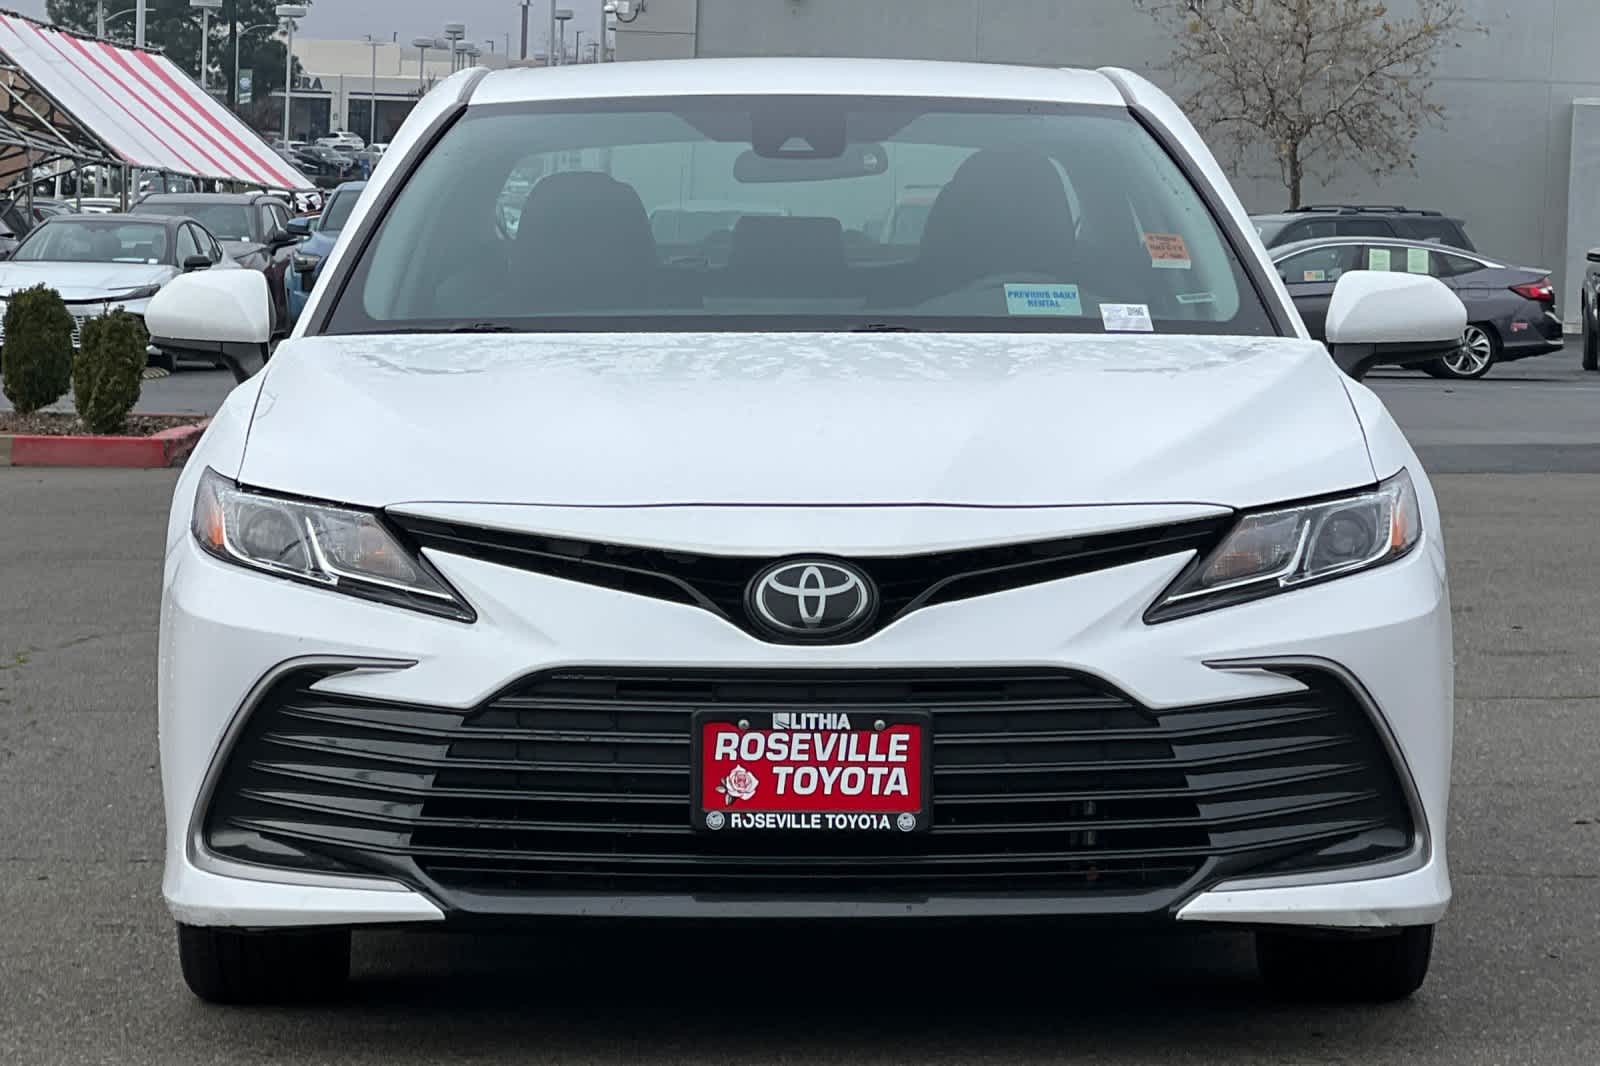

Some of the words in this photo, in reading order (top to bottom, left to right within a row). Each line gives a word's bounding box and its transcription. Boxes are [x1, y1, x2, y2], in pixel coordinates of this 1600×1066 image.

[790, 713, 851, 730] LITHIA
[714, 732, 910, 762] ROSEVILLE
[772, 766, 909, 796] TOYOTA
[731, 813, 821, 829] ROSEVILLE
[825, 814, 891, 830] TOYOTA
